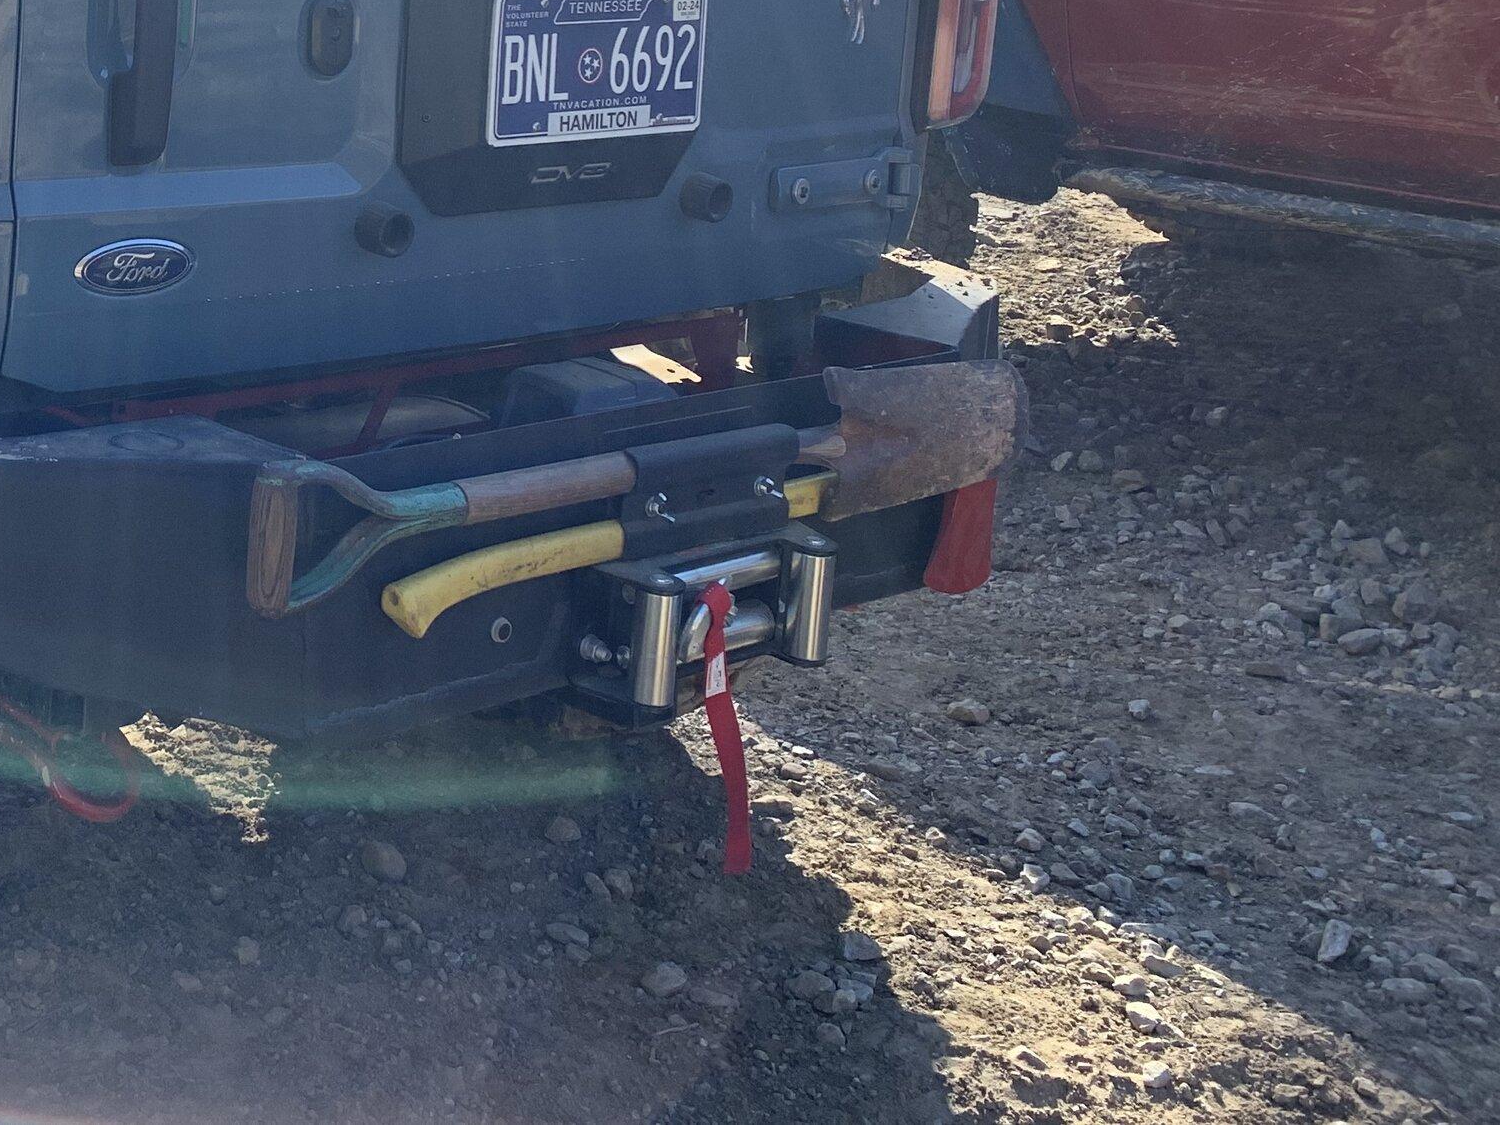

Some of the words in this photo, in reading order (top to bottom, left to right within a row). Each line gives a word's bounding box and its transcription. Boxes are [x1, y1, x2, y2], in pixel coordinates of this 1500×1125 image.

[569, 0, 643, 14] TENNESSEE
[677, 0, 700, 11] 02-24
[505, 11, 549, 19] VOLUNTEER
[505, 20, 528, 28] STATE
[501, 32, 569, 105] BNL
[609, 24, 697, 94] 6692
[553, 95, 647, 111] TNVACATION.COM
[559, 111, 638, 132] HAMILTON
[106, 252, 171, 282] Ford
